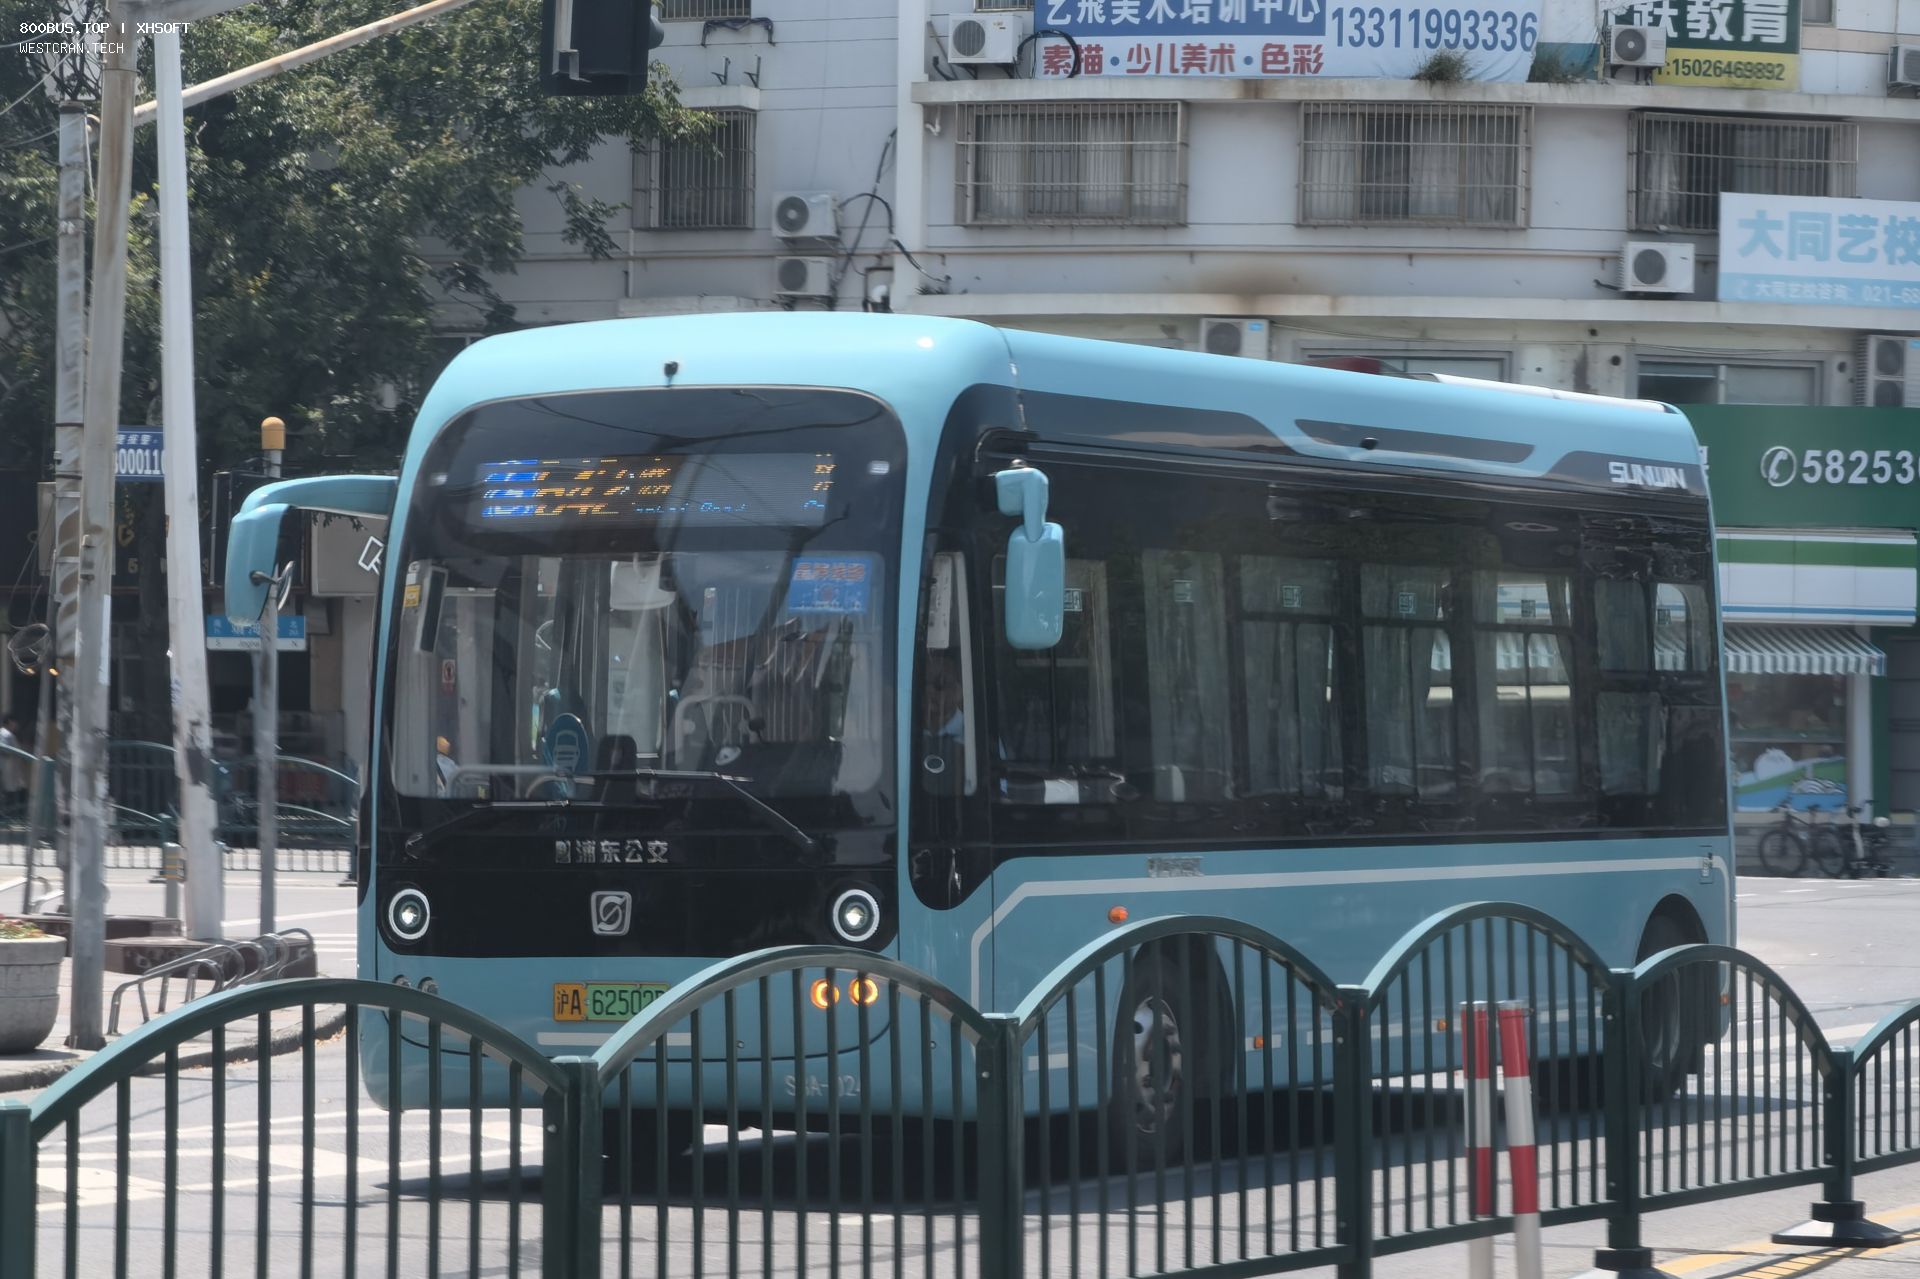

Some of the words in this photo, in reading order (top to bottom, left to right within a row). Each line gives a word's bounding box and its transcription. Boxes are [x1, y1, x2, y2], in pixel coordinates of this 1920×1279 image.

[1332, 7, 1537, 51] 13311993336
[1737, 210, 1920, 267] 大同艺校
[1802, 449, 1920, 485] 58253
[576, 839, 668, 863] 浦东公交
[556, 989, 582, 1015] 沪A
[592, 989, 665, 1015] 62502
